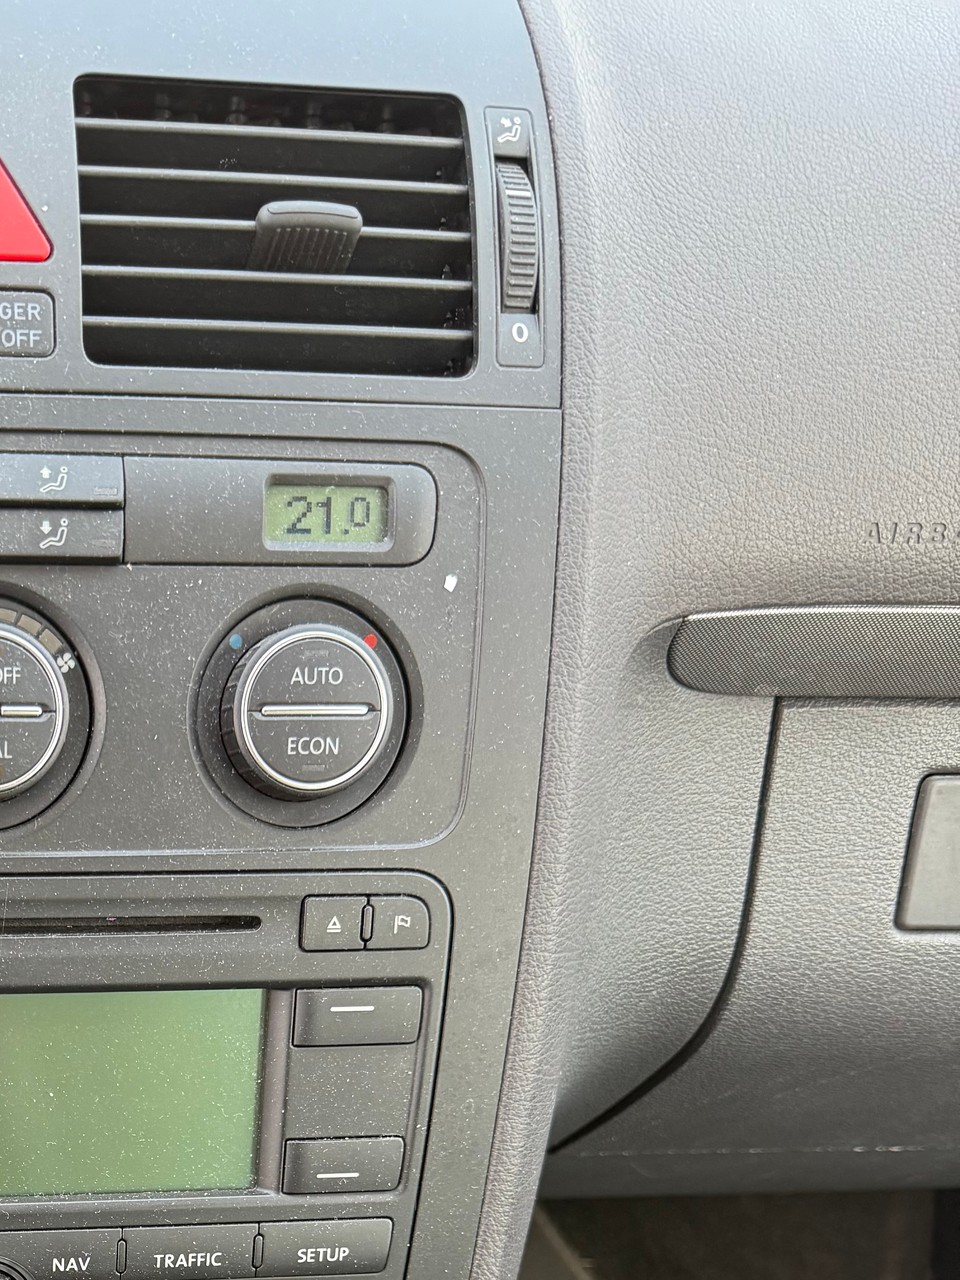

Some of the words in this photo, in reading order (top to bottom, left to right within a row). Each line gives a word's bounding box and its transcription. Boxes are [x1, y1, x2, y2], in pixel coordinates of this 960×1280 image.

[1, 328, 42, 348] OFF
[511, 322, 529, 343] 0
[286, 496, 370, 534] 21.0
[290, 667, 343, 685] AUTO
[287, 737, 340, 755] ECON
[154, 1251, 223, 1269] TRAFFIC
[297, 1246, 350, 1264] SETUP
[51, 1257, 92, 1273] NAV
